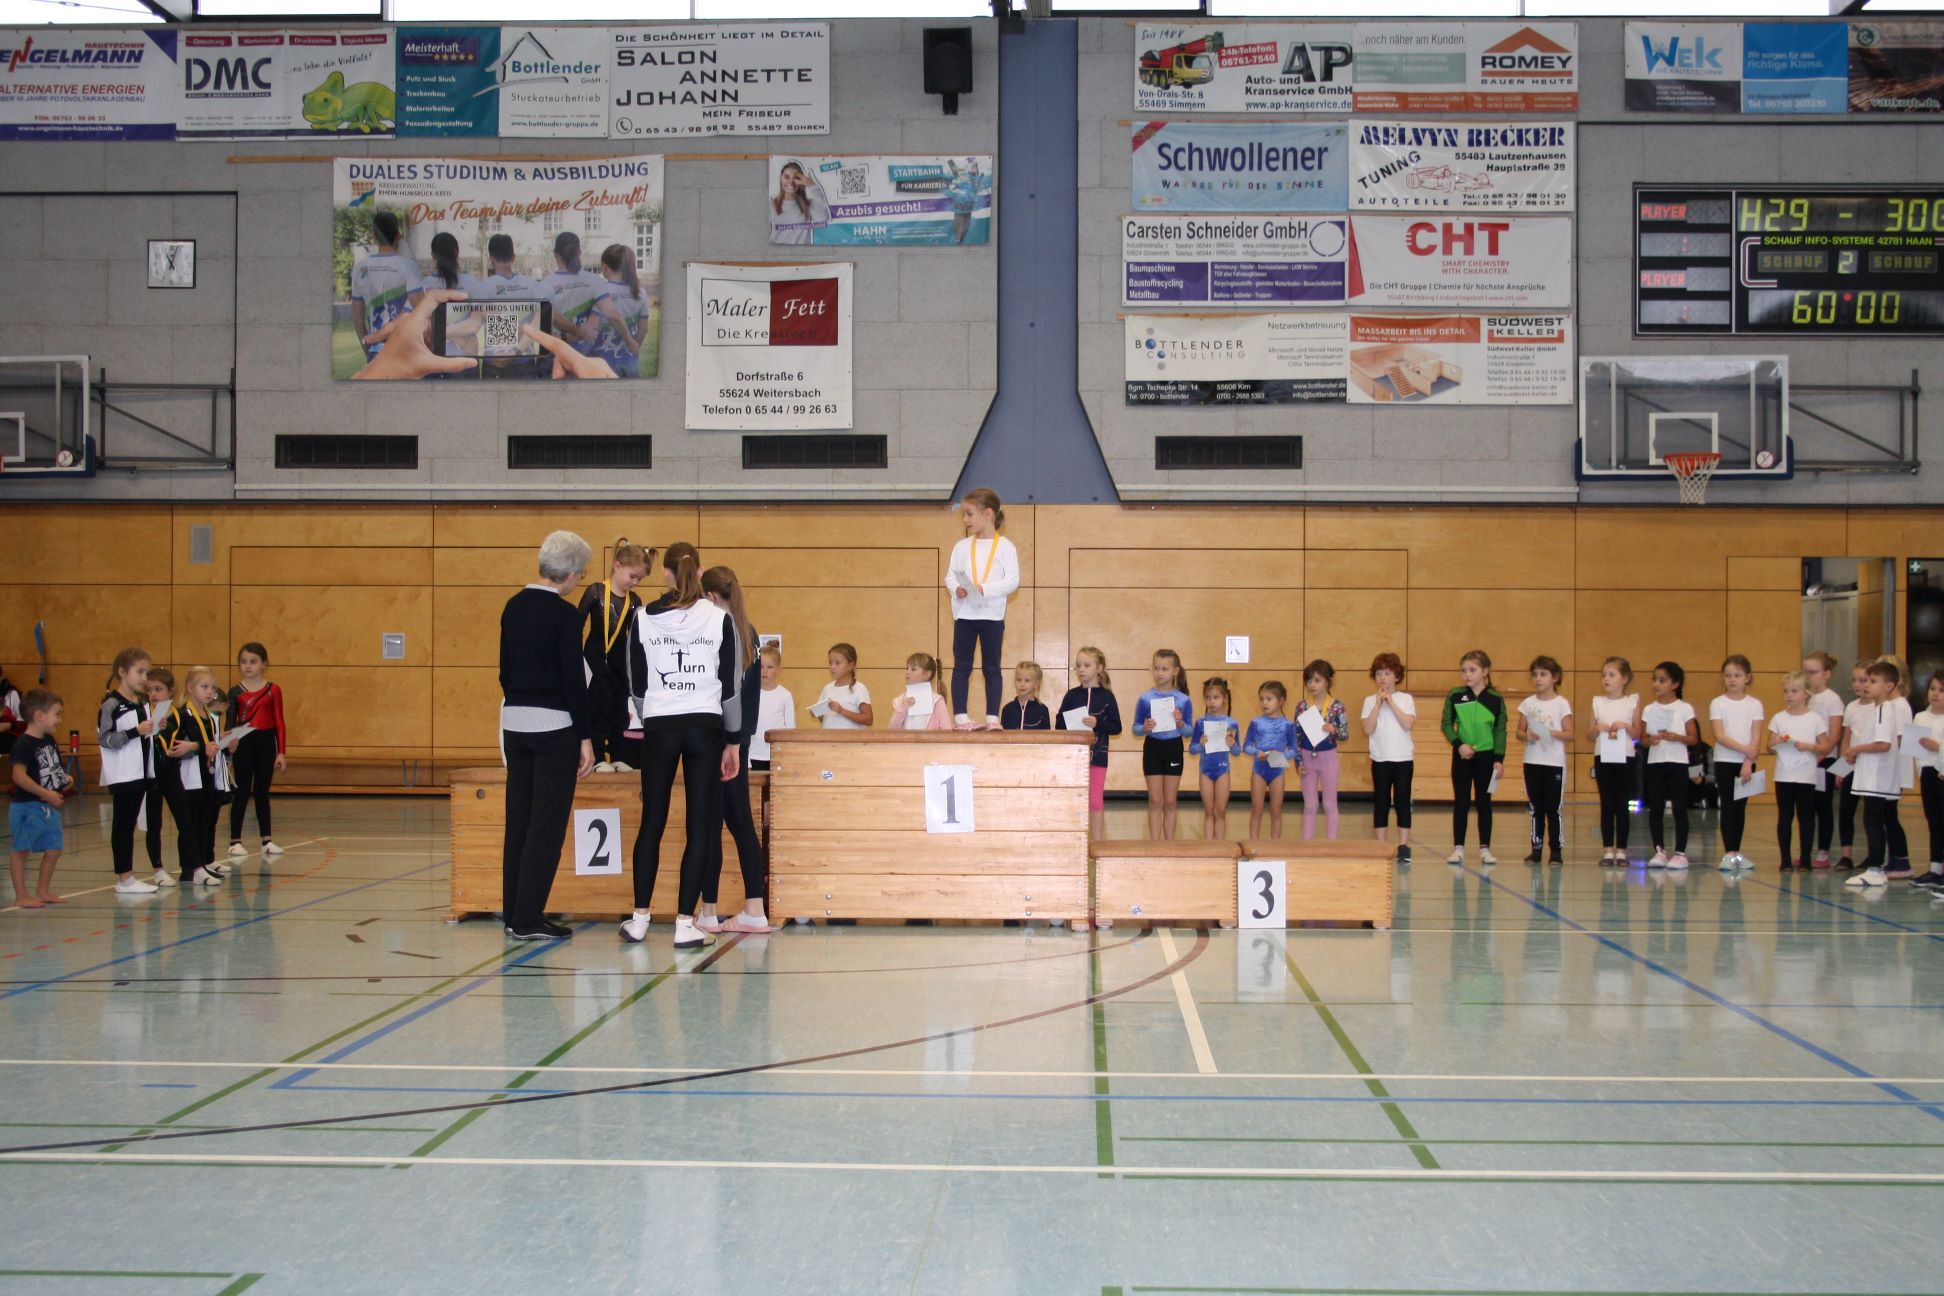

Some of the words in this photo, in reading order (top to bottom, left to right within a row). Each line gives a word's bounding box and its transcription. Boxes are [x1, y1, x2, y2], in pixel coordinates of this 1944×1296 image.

[722, 32, 756, 40] LIEGT
[761, 31, 774, 39] IM
[780, 30, 825, 39] DETAIL
[1389, 35, 1413, 45] näher
[1416, 37, 1429, 45] am
[1431, 35, 1467, 45] Kunden.
[405, 43, 459, 54] Meisterhaft
[1221, 45, 1275, 57] 24h-Telefon:
[0, 46, 144, 68] ENGELMANN
[617, 50, 717, 67] SALON
[1789, 51, 1799, 59] für
[512, 61, 601, 74] Bottlender
[1282, 42, 1353, 83] AP
[1481, 56, 1573, 69] ROMEY
[1748, 60, 1788, 72] richtige
[1790, 60, 1825, 69] Klima.
[186, 58, 272, 91] DMC
[679, 68, 813, 85] ANNETTE
[1245, 75, 1276, 85] Auto-
[1279, 75, 1301, 85] und
[0, 84, 78, 95] ALTERNATIVE
[82, 84, 145, 95] ENERGIEN
[1139, 90, 1198, 99] Von-Drais-Str.
[1198, 90, 1204, 99] 8
[1245, 86, 1315, 96] Kranservice
[1318, 86, 1353, 96] GmbH
[512, 93, 601, 103] Stuckateurbetrieb
[616, 89, 739, 107] JOHANN
[1139, 100, 1167, 109] 55469
[1168, 100, 1206, 110] Simmern
[1245, 100, 1353, 111] www.ap-kranservice.de
[703, 111, 732, 119] MEIN
[738, 110, 792, 118] FRISEUR
[406, 121, 473, 129] Fassadengestaltung
[1360, 125, 1459, 147] MELVYN
[1468, 127, 1565, 147] BECKER
[1158, 142, 1329, 172] Schwollener
[1455, 153, 1486, 161] 55483
[1489, 153, 1567, 161] Lautzenhausen
[350, 164, 418, 180] DUALES
[424, 164, 508, 181] STUDIUM
[514, 168, 526, 181] &
[533, 162, 649, 181] AUSBILDUNG
[893, 168, 940, 178] STARTBAHN
[1358, 150, 1421, 190] TUNING
[1486, 164, 1550, 174] Hauptstraße
[1553, 164, 1566, 172] 39
[901, 182, 915, 190] FÜR
[916, 182, 947, 190] KARRIEREN
[411, 202, 446, 225] Das
[450, 200, 496, 222] Team
[526, 197, 571, 215] deine
[574, 184, 649, 212] Zukunft!
[1358, 198, 1450, 206] AUTOTEILE
[837, 207, 873, 217] Azubis
[875, 203, 922, 216] gesucht!
[1641, 206, 1686, 219] PLAYER
[853, 226, 887, 236] HAHN
[1127, 220, 1182, 240] Carsten
[1186, 220, 1259, 239] Schneider
[1263, 221, 1308, 239] GmbH
[1406, 222, 1510, 257] CHT
[1764, 237, 1802, 246] SCHAUF
[1805, 237, 1875, 246] INFO-SYSTEME
[1877, 237, 1903, 246] 42781
[1906, 237, 1933, 246] HAAN
[1763, 256, 1824, 268] SCHAUF
[1839, 252, 1854, 274] 2
[1874, 256, 1934, 268] SCHAUF
[1129, 264, 1176, 273] Baumaschinen
[1129, 279, 1184, 289] Baustoffrecycling
[1641, 273, 1686, 287] PLAYER
[1370, 282, 1382, 290] Die
[1384, 282, 1399, 290] CHT
[1400, 283, 1428, 292] Gruppe
[1433, 283, 1461, 291] Chemie
[1463, 283, 1474, 291] für
[1476, 283, 1504, 291] höchste
[1506, 283, 1546, 292] Ansprüche
[1129, 290, 1160, 299] Metallbau
[452, 305, 484, 313] WEITERE
[486, 305, 508, 313] INFOS
[707, 298, 768, 317] Maler
[782, 298, 827, 320] Fett
[1268, 322, 1346, 331] Netzwerkbetreuung
[1488, 317, 1564, 326] SÜDWEST
[718, 329, 741, 339] Die
[745, 329, 817, 339] Kreativen
[1357, 327, 1407, 336] MASSARBEIT
[1409, 328, 1422, 336] BIS
[1424, 328, 1438, 336] INS
[1439, 328, 1466, 336] DETAIL
[737, 372, 794, 382] Dorfstraße
[797, 372, 804, 382] 6
[719, 389, 751, 399] 55624
[753, 388, 821, 399] Weitersbach
[1128, 384, 1145, 393] Bgm.
[703, 405, 742, 415] Telefon
[745, 405, 752, 415] 0
[755, 405, 768, 415] 65
[770, 405, 784, 415] 44
[793, 405, 806, 415] 99
[809, 405, 822, 414] 26
[824, 405, 838, 414] 63
[941, 775, 957, 825] 1
[588, 818, 611, 868] 2
[1252, 869, 1275, 920] 3
